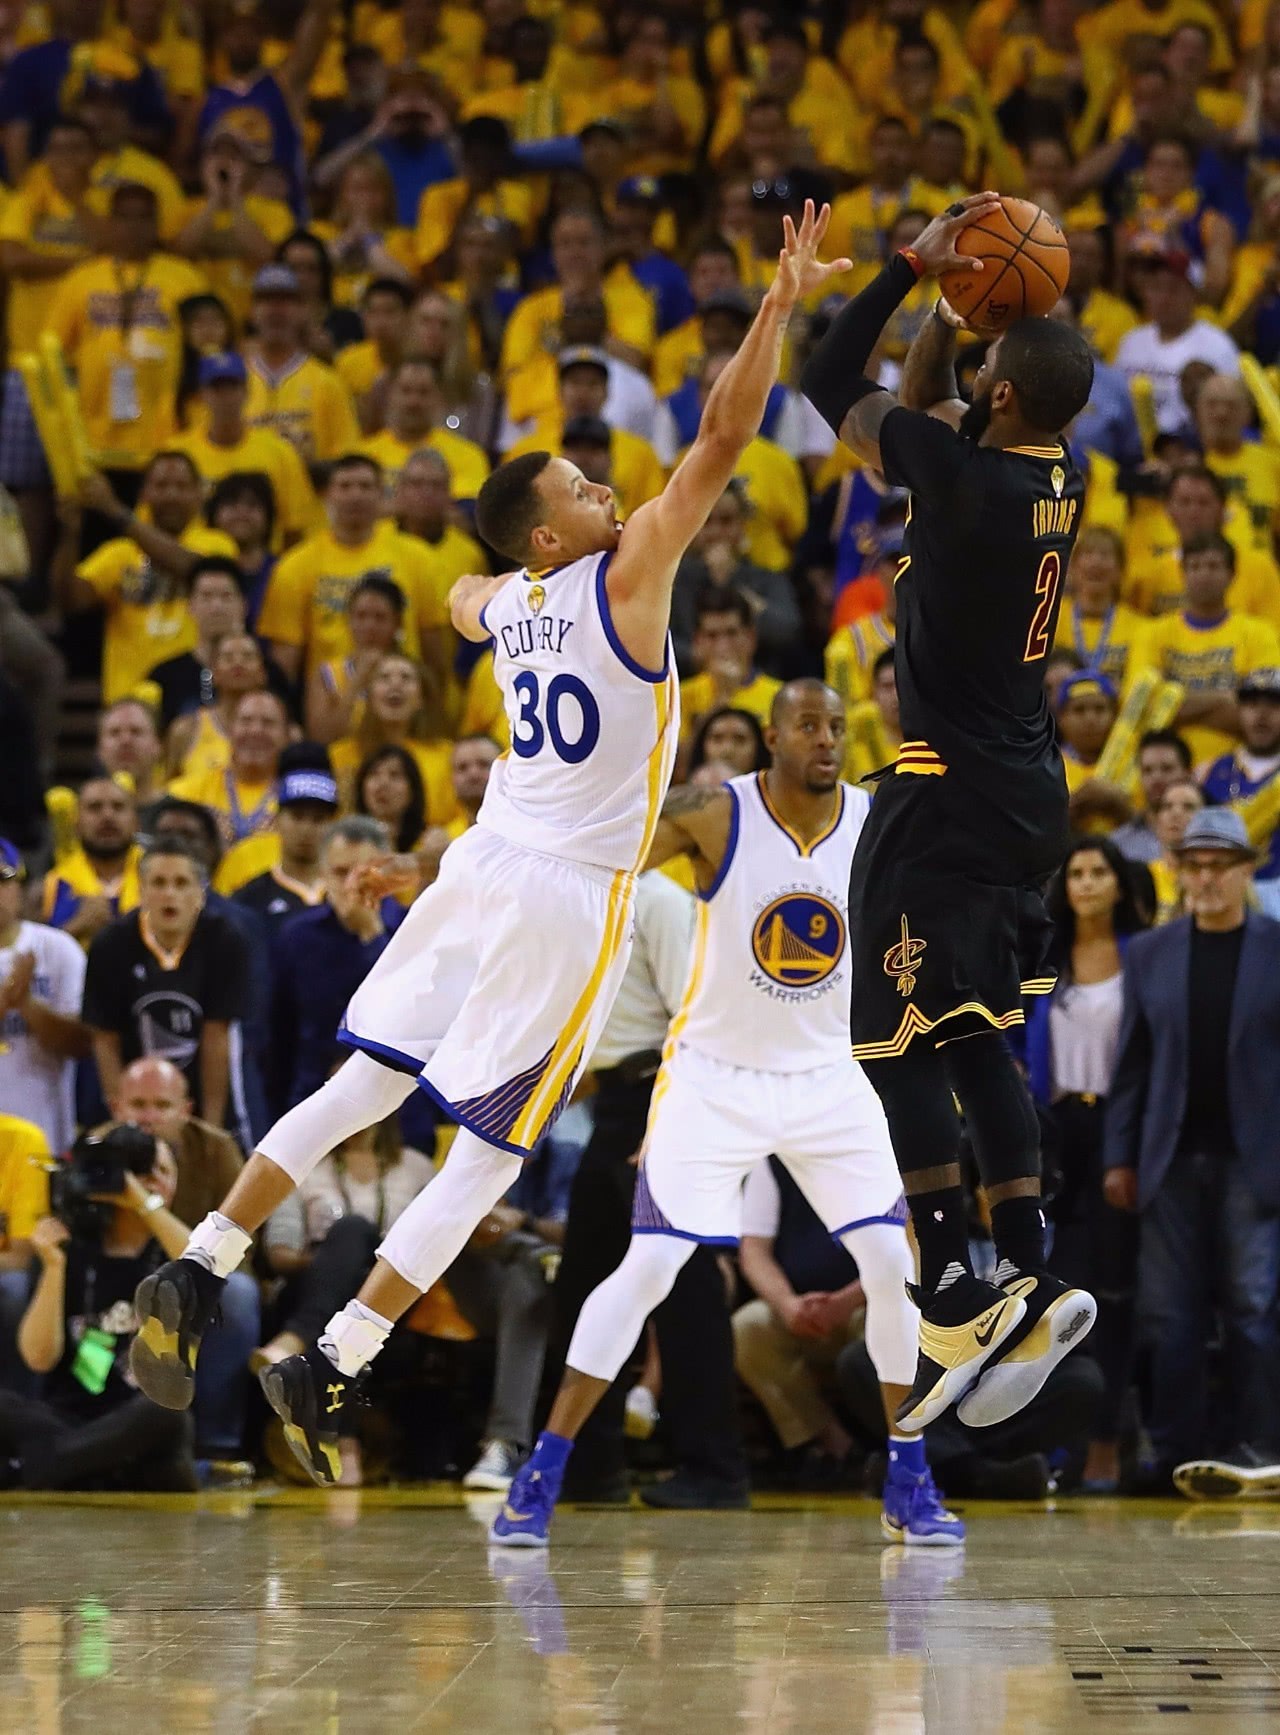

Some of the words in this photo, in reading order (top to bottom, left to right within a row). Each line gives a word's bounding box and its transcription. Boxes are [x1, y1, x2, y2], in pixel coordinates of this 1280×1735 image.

[1033, 499, 1077, 538] IRVING
[1023, 551, 1061, 662] 2
[501, 616, 574, 658] CURY
[512, 671, 600, 764] 30
[808, 913, 828, 939] 9
[749, 968, 844, 1003] WARRIORS
